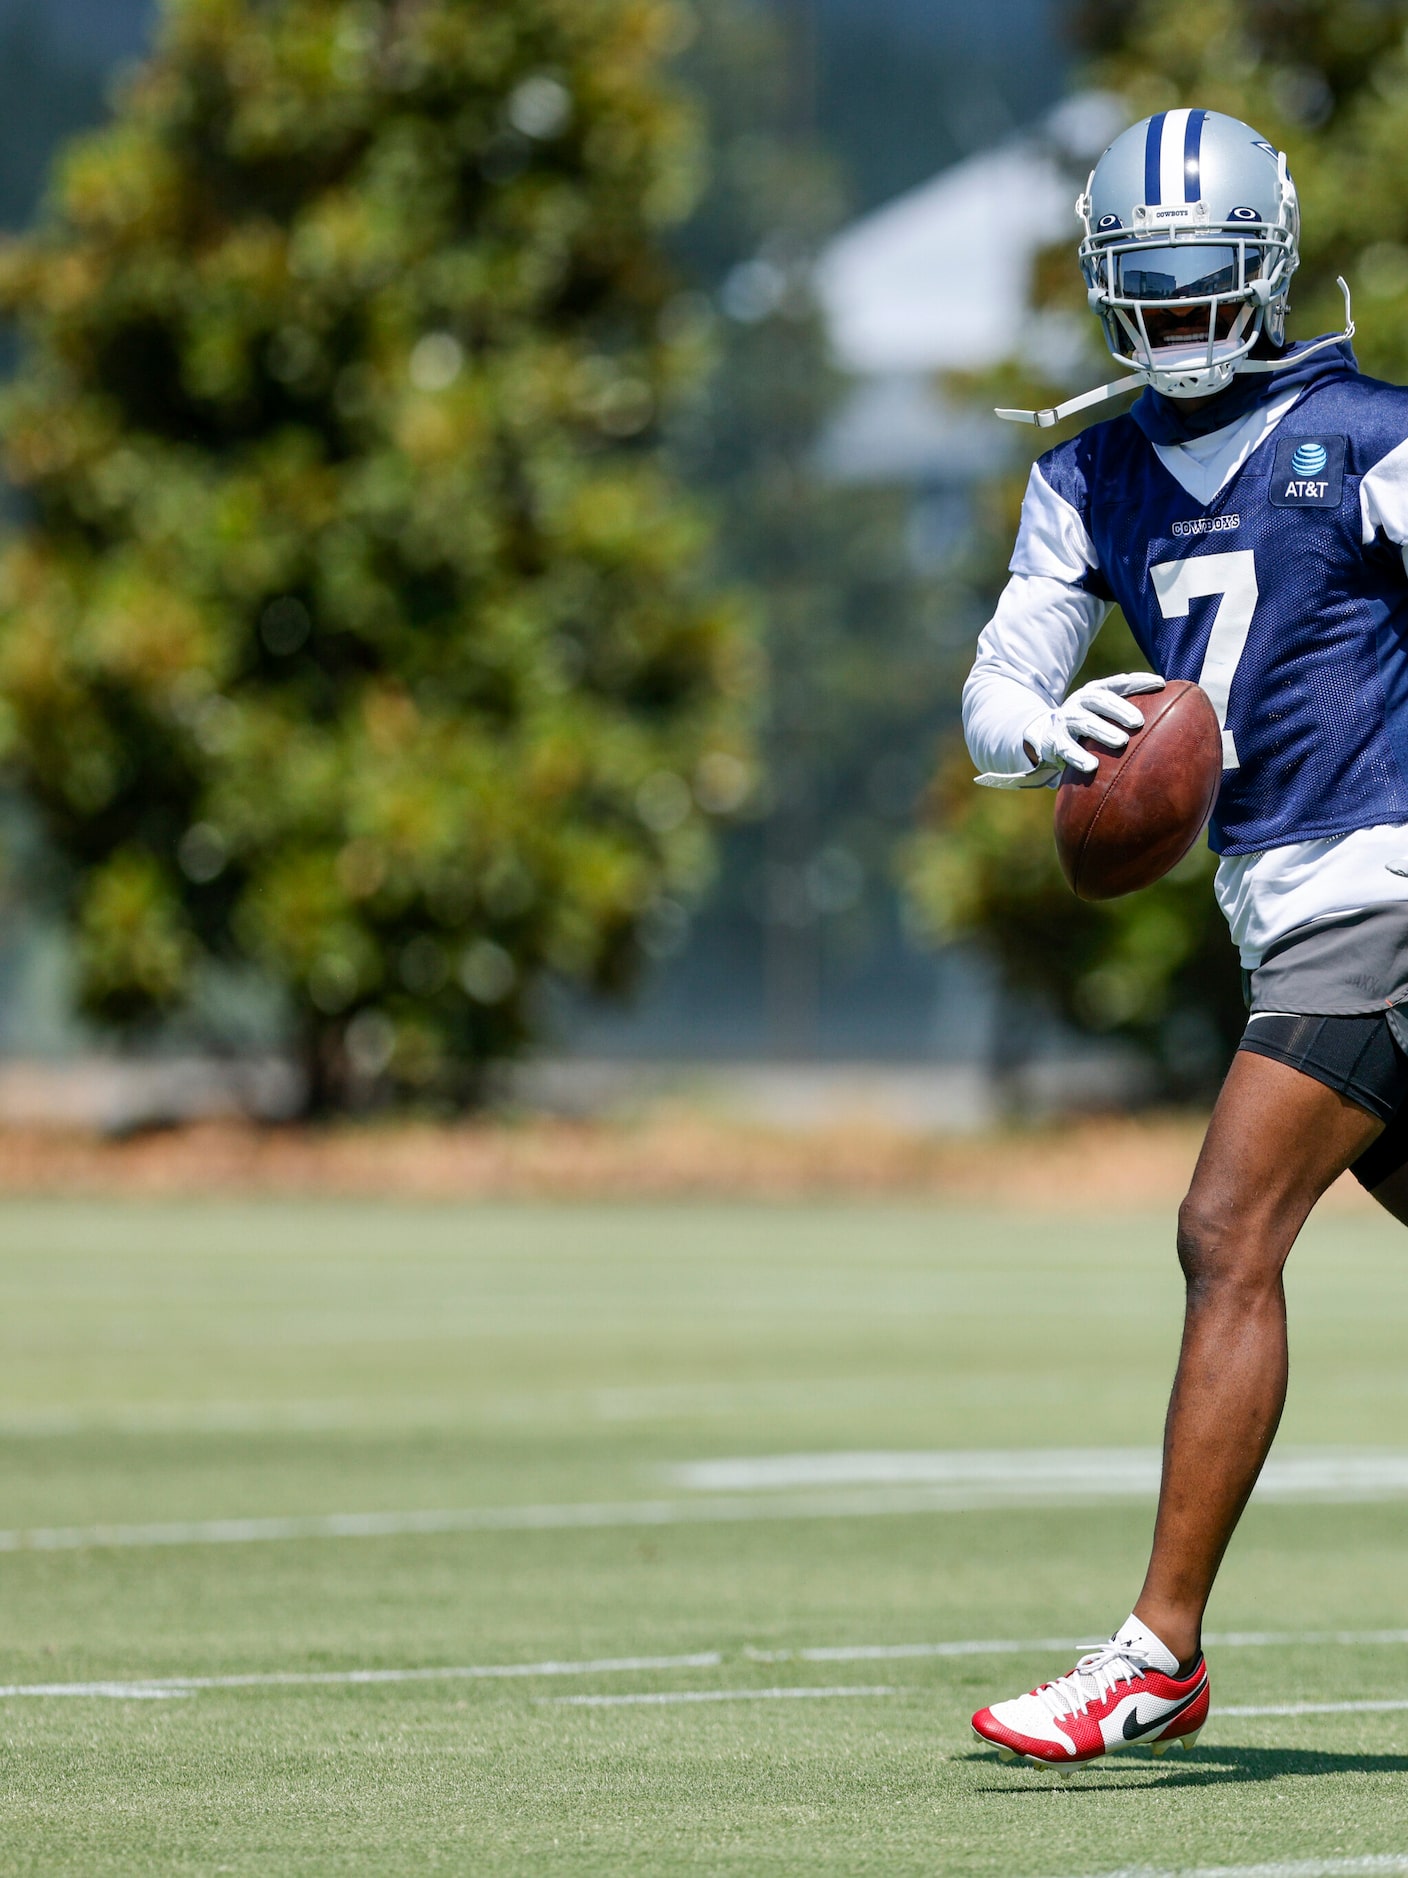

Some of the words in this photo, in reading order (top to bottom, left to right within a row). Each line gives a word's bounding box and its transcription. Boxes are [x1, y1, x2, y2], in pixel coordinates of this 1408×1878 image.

[1156, 210, 1189, 218] COWBOYS
[1285, 481, 1329, 498] AT&T
[1171, 513, 1240, 537] COWBOYS
[1150, 549, 1259, 769] 7
